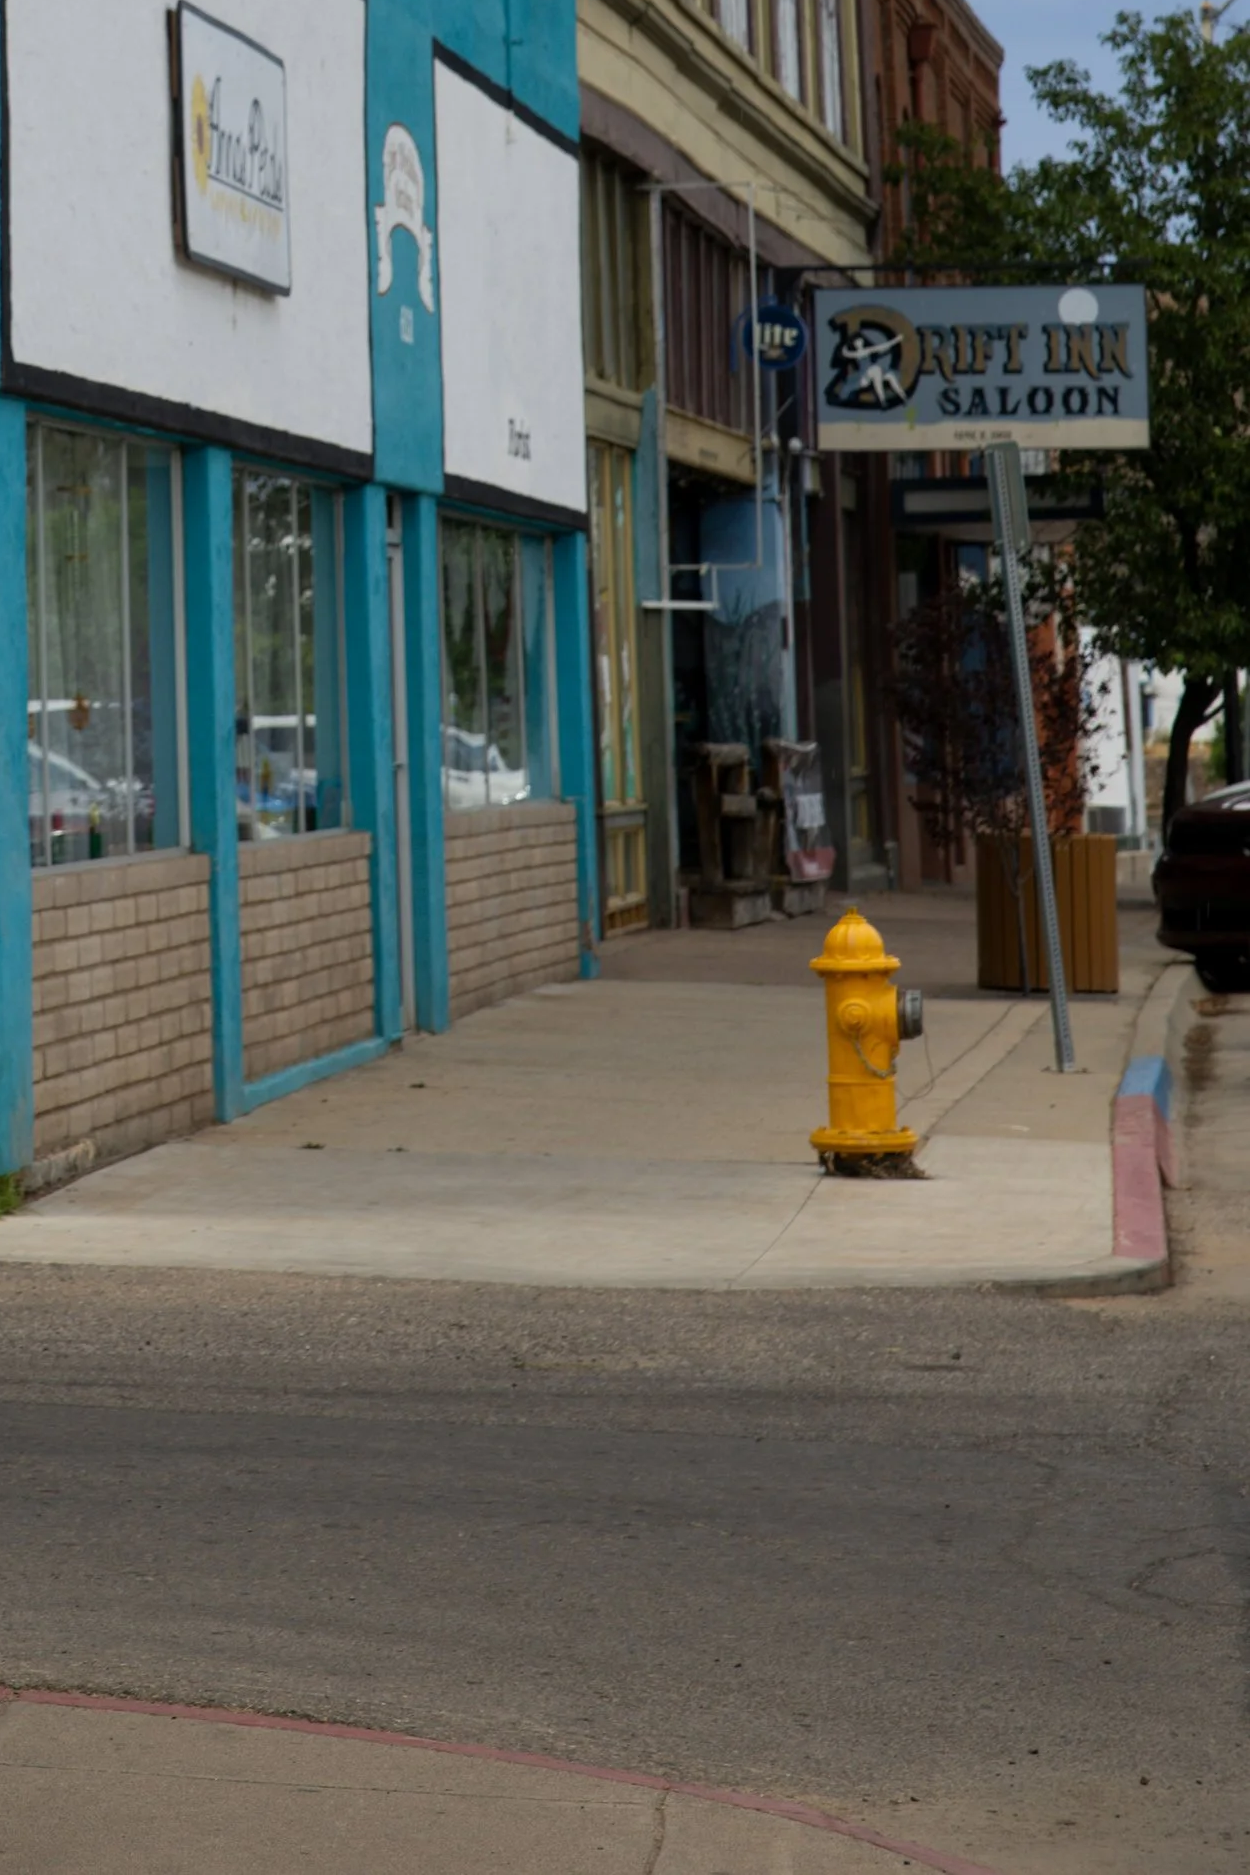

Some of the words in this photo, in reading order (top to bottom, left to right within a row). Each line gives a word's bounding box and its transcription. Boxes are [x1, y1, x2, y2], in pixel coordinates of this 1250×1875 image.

[824, 303, 1029, 412] DRIFT
[1042, 321, 1134, 380] INN
[936, 384, 1121, 417] SALOON
